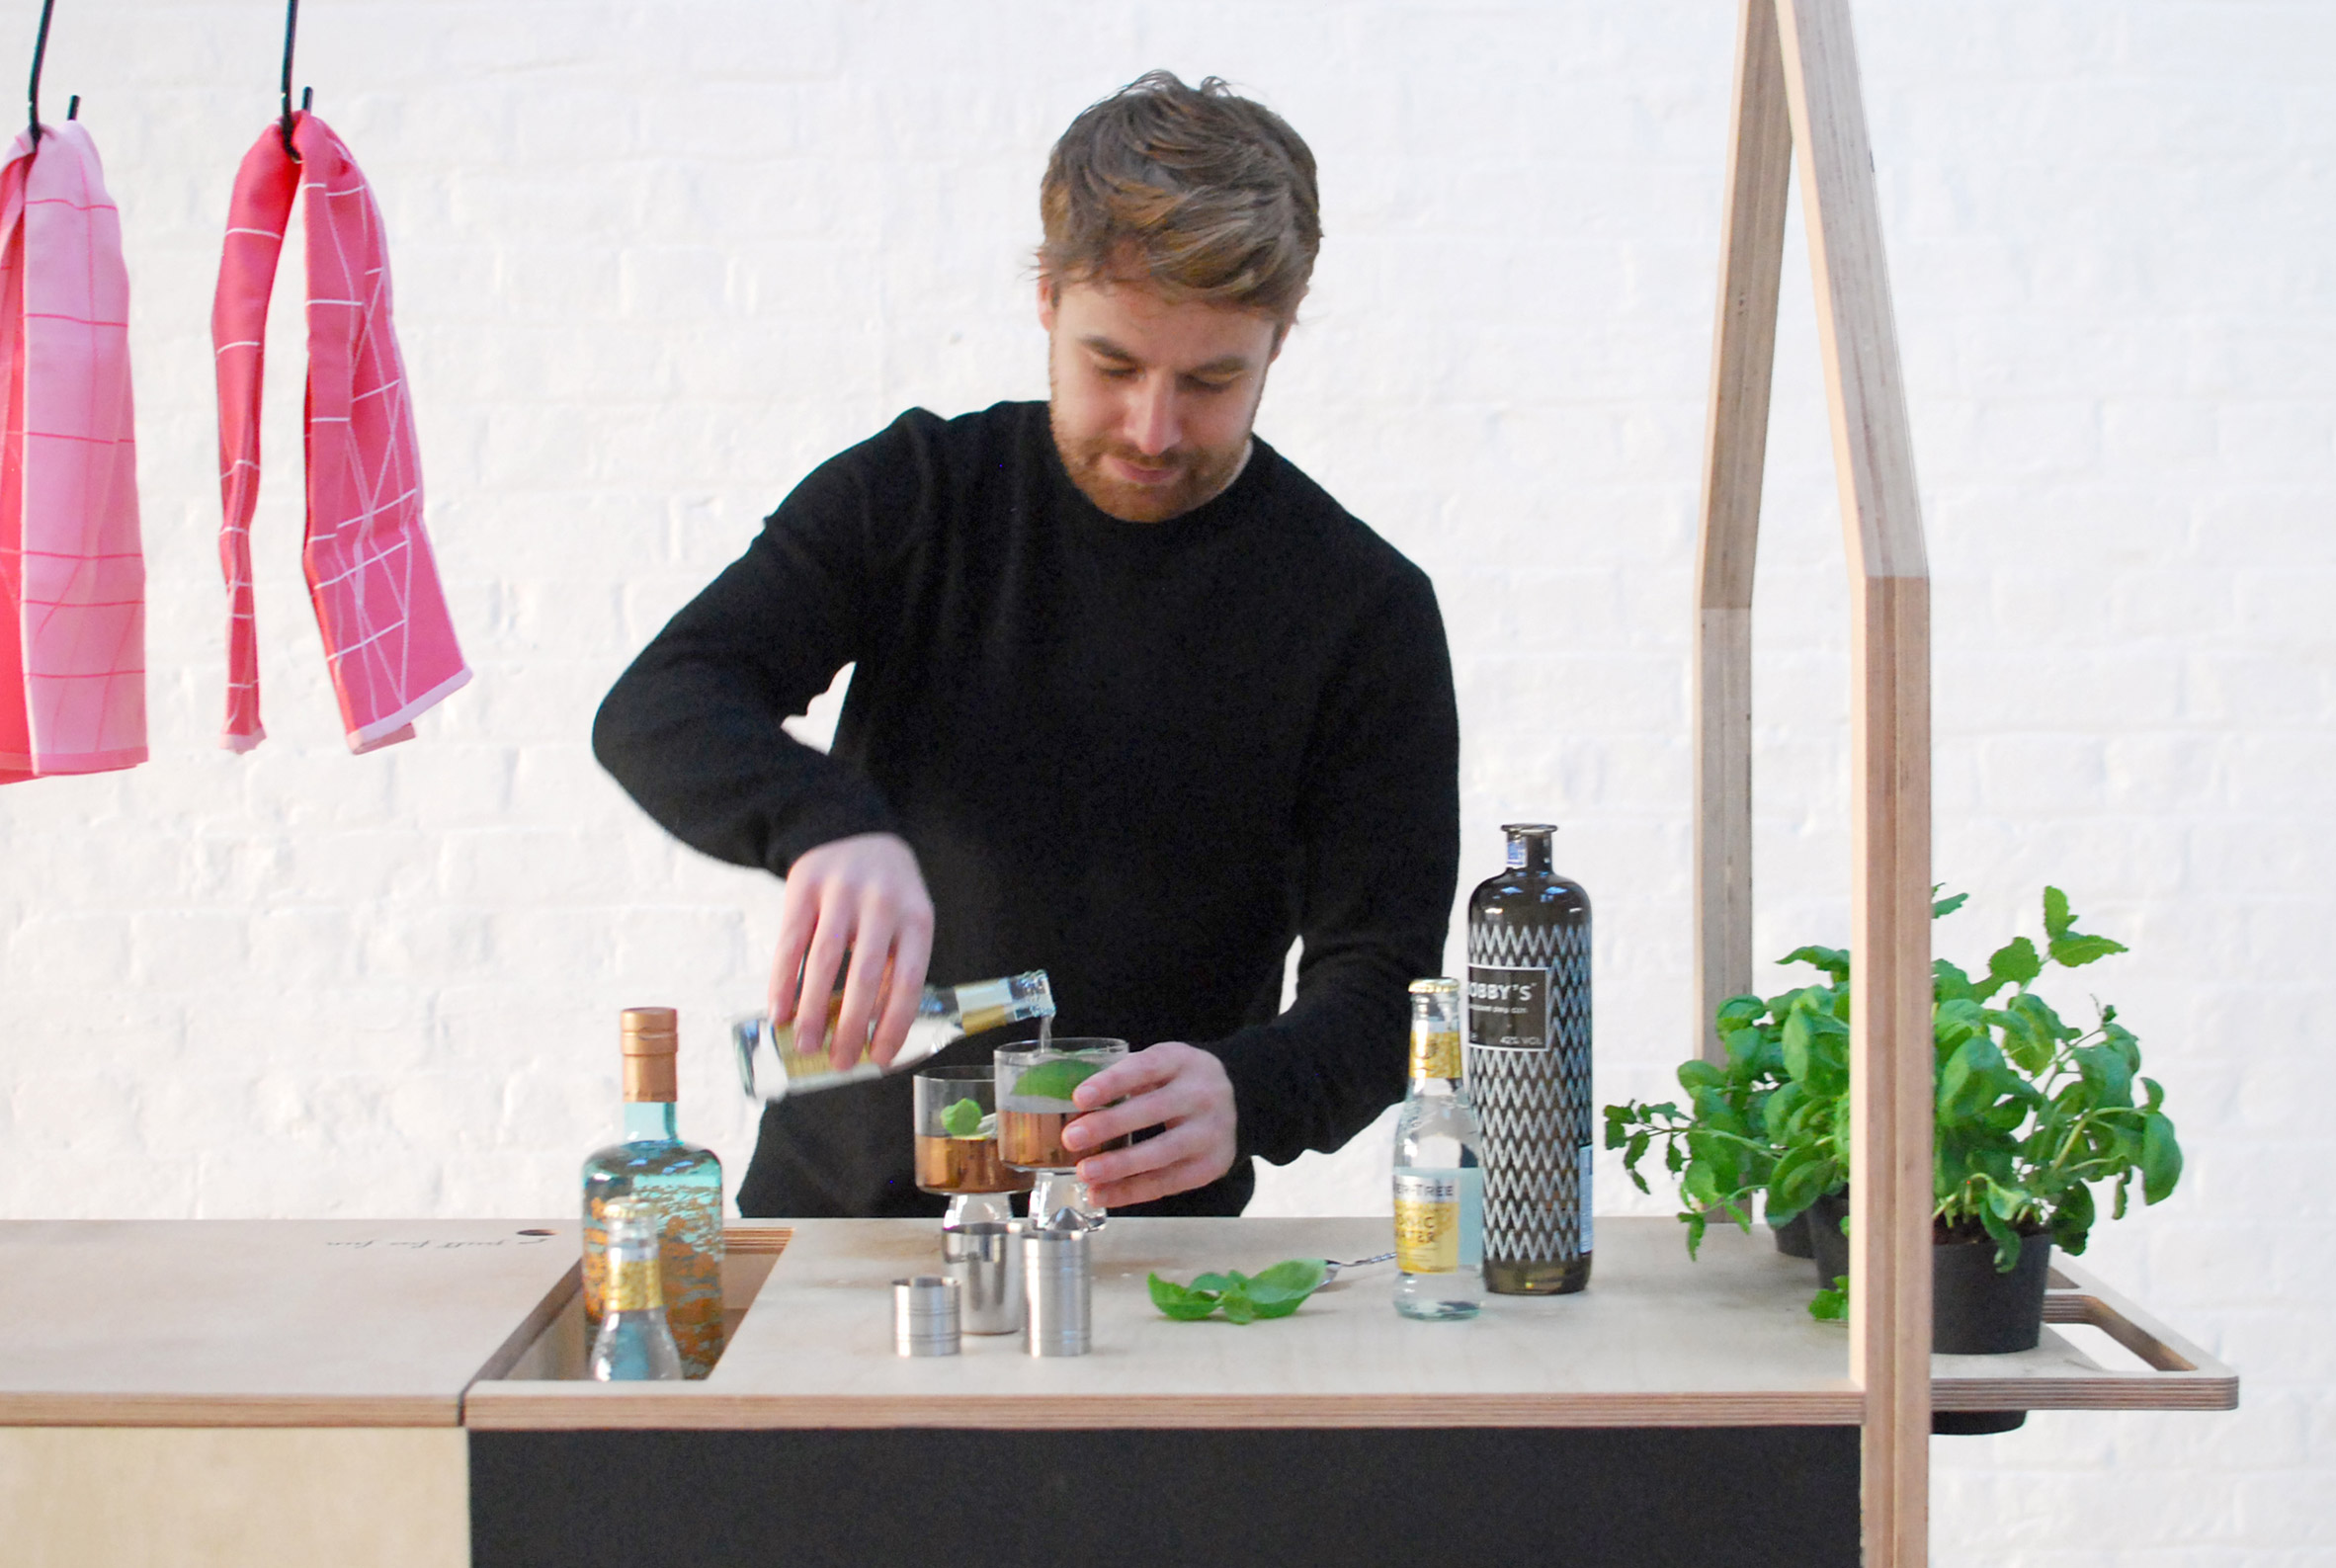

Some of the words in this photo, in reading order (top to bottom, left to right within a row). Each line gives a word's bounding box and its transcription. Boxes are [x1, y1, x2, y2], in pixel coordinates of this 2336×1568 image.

[1469, 981, 1533, 1000] OBBY'S
[1394, 1184, 1454, 1197] ER-TREE
[1395, 1214, 1436, 1229] ONIC
[1395, 1230, 1437, 1243] ATER
